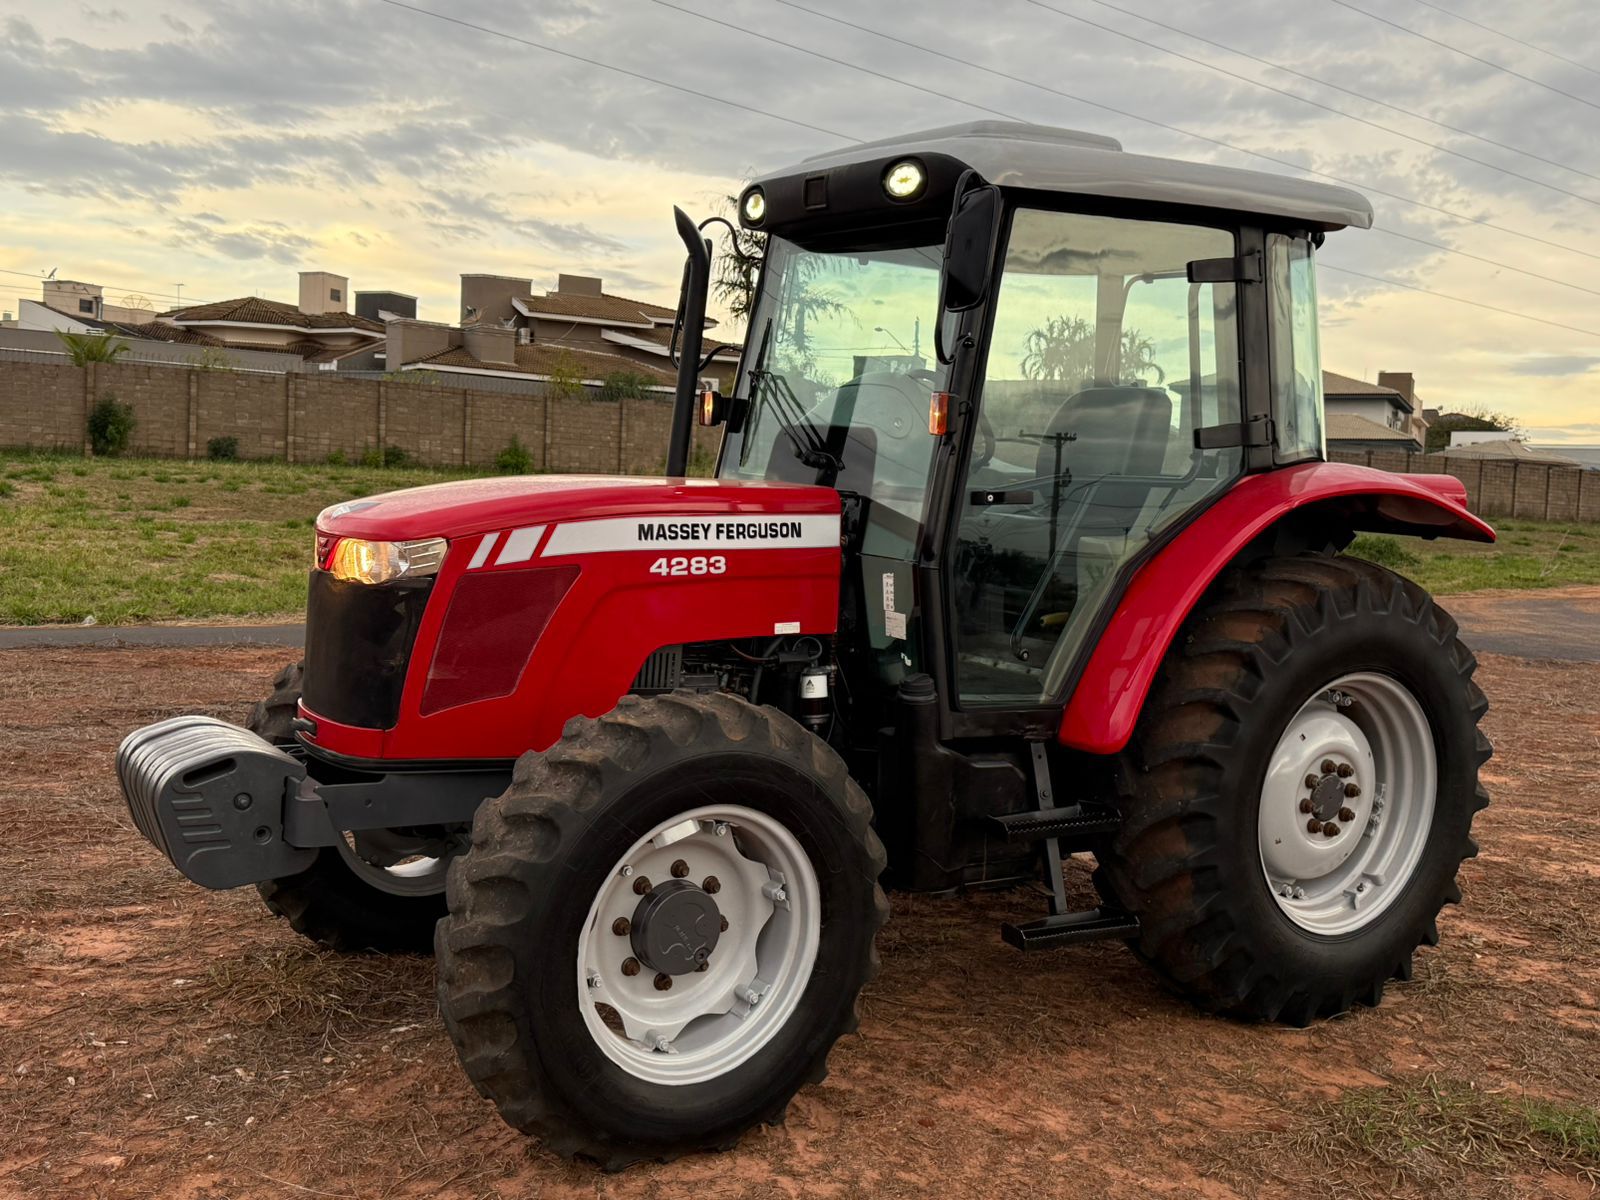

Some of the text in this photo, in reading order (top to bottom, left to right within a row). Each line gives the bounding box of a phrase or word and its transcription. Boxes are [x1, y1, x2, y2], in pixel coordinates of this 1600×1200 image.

[638, 522, 802, 541] MASSEY FERGUSON
[649, 556, 726, 576] 4283
